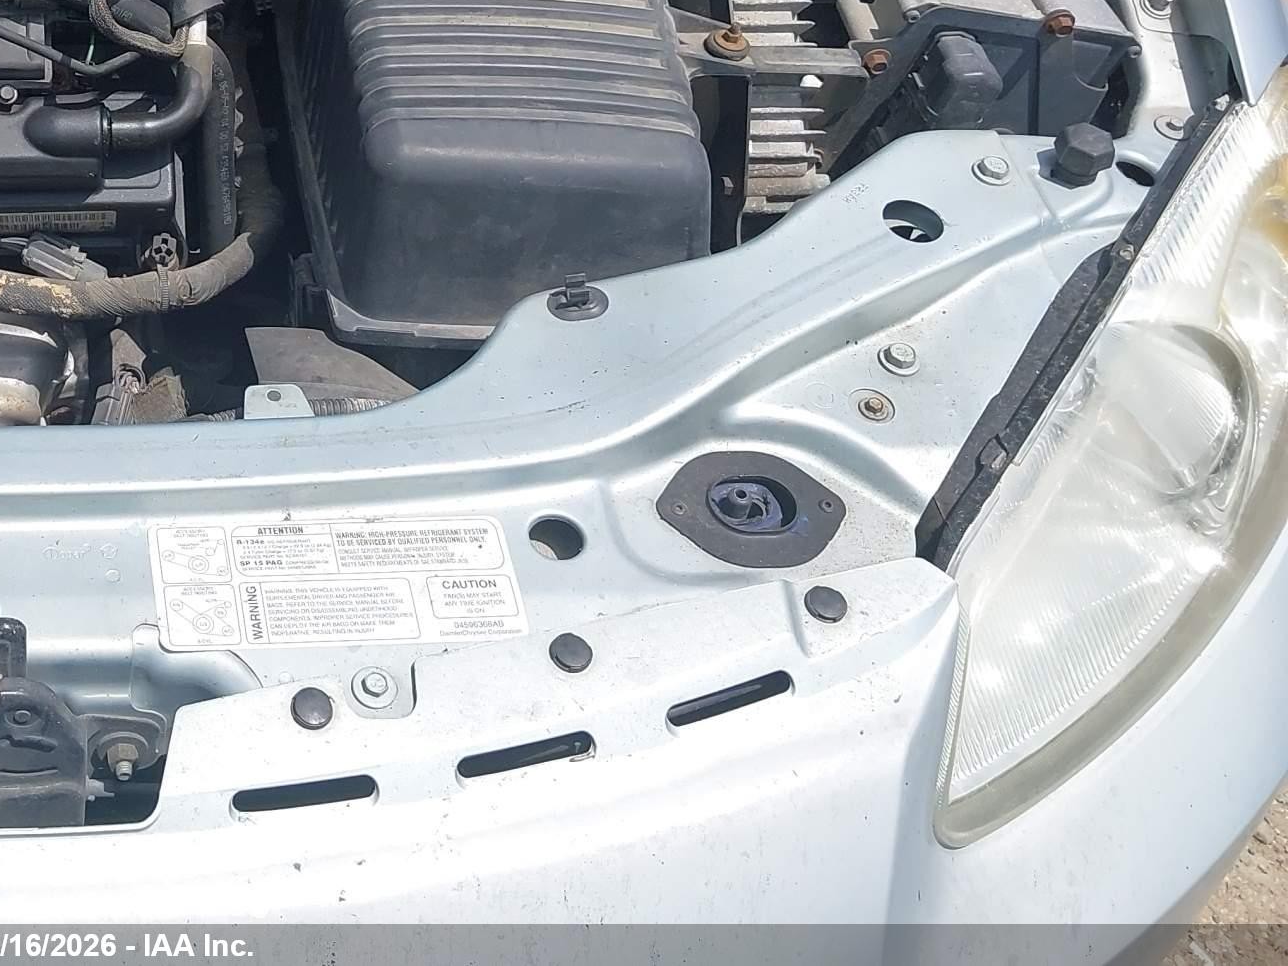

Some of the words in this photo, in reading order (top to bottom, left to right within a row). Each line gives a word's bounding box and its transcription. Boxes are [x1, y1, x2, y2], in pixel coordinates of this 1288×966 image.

[357, 538, 386, 546] SERVICED
[442, 579, 497, 590] CAUTION
[246, 586, 264, 640] WARNING
